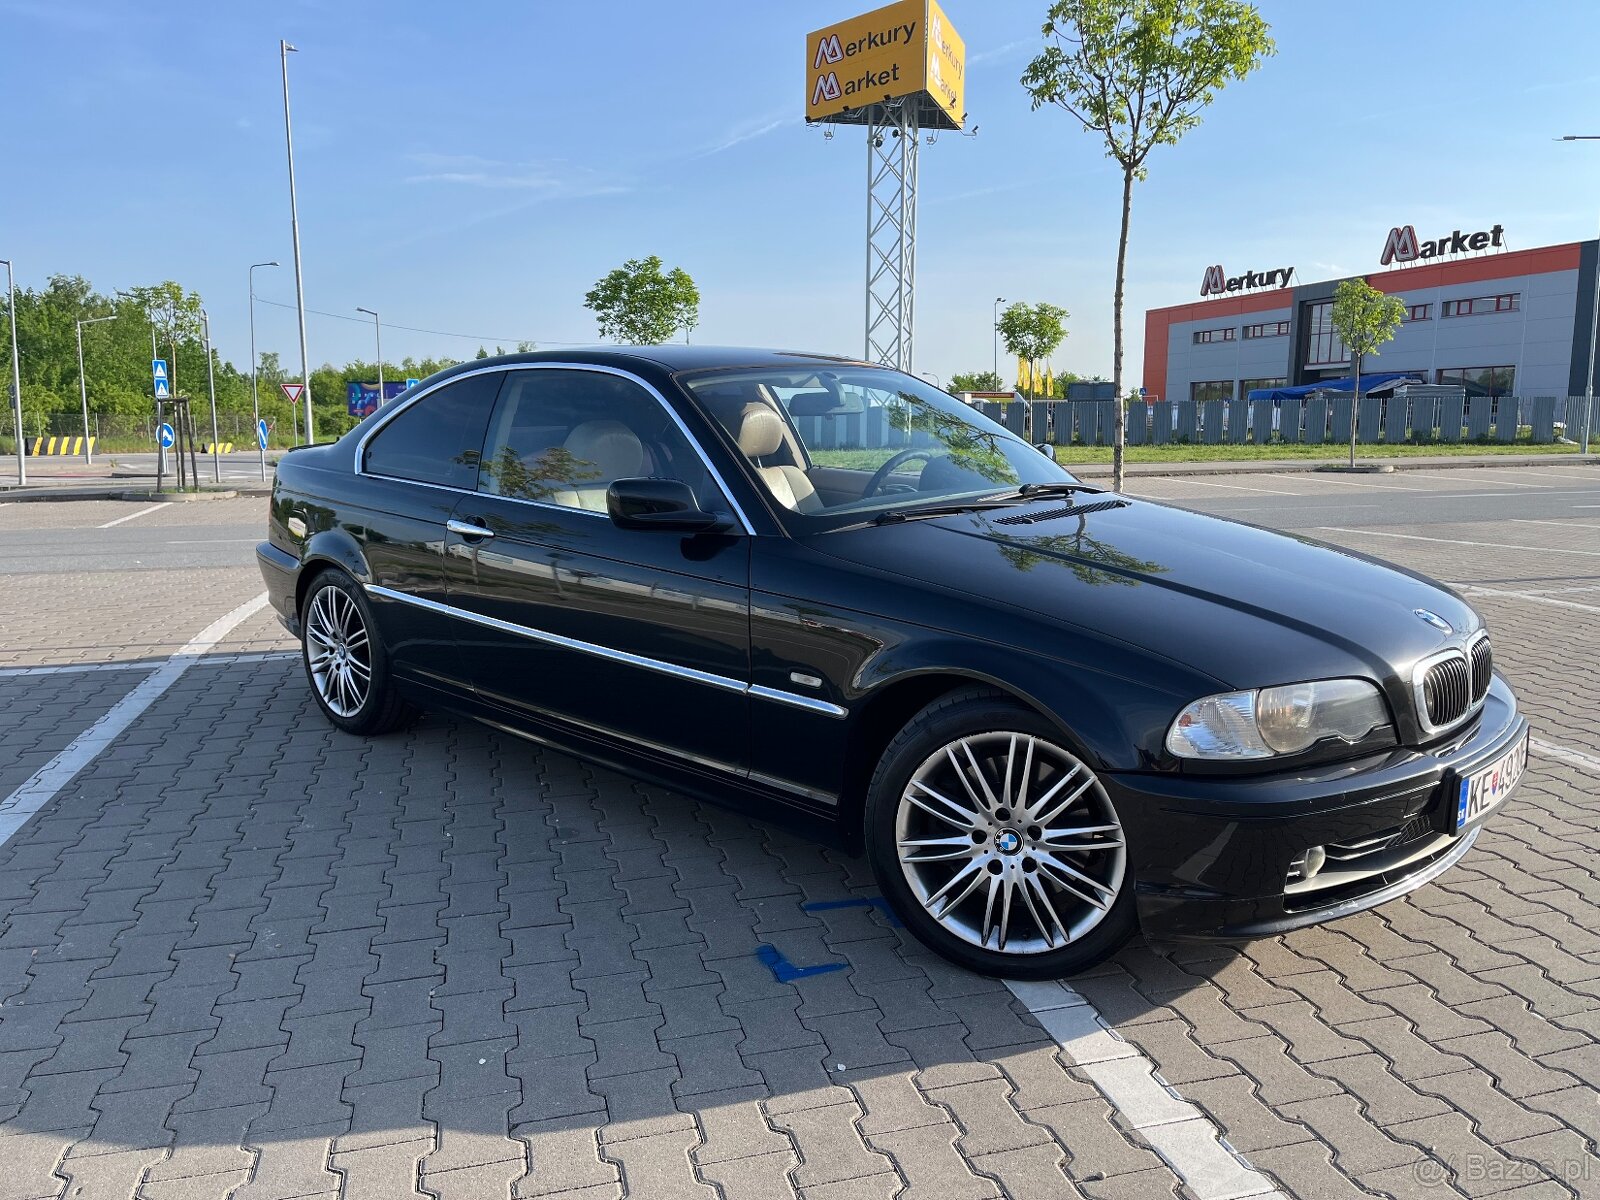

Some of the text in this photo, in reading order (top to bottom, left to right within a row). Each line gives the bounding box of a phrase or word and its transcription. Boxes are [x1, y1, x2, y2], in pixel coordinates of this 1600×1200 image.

[813, 21, 916, 69] Merkury
[931, 12, 963, 80] Merkury
[811, 63, 900, 105] Market
[1380, 224, 1504, 265] Market
[1200, 265, 1295, 296] Merkury
[1467, 770, 1493, 817] KE
